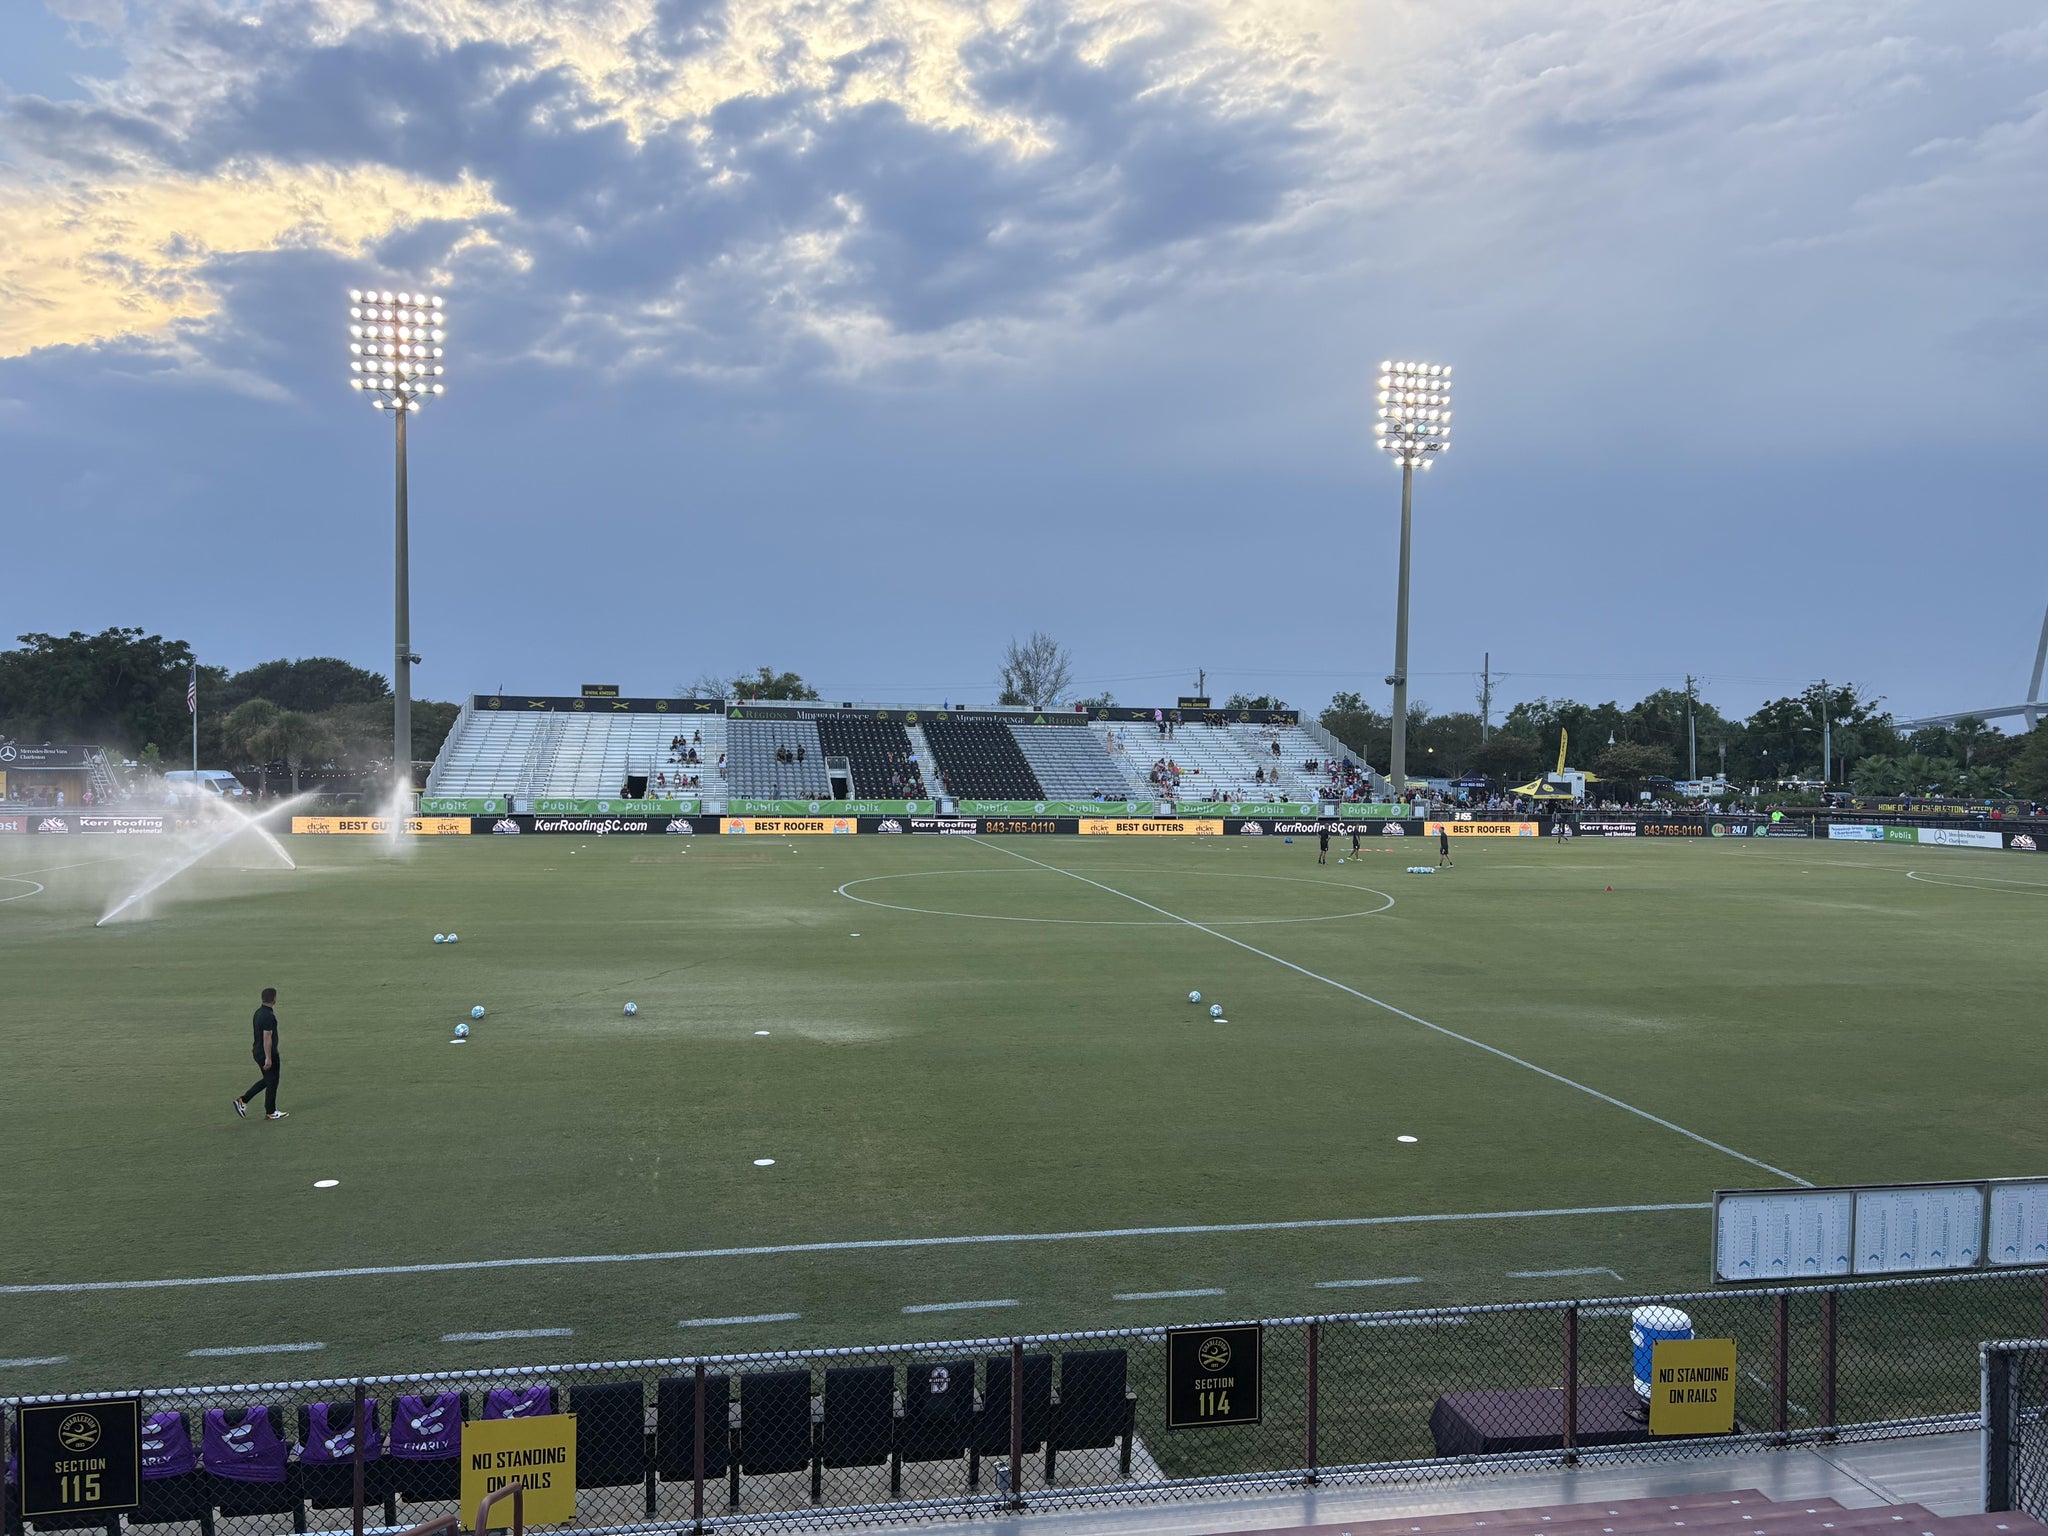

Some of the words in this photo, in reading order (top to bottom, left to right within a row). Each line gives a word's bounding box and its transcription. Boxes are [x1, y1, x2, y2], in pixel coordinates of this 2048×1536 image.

[746, 711, 788, 719] REGIONS
[1049, 716, 1087, 725] REGIONS
[430, 801, 468, 811] Publix
[542, 801, 580, 812] Publix
[626, 802, 662, 812] Publix
[746, 803, 780, 812] Publix
[845, 804, 879, 812] Publix
[976, 803, 1008, 812] Publix
[1068, 804, 1100, 813] Publix
[1184, 805, 1215, 813] Publix
[1254, 806, 1284, 814] Publix
[1348, 806, 1379, 814] Publix
[113, 819, 163, 827] Roofing
[339, 822, 368, 830] BEST
[371, 822, 423, 831] GUERS
[534, 819, 648, 834] KerrRoofingSC.com
[755, 822, 780, 831] BEST
[784, 822, 824, 831] ROOFER
[938, 821, 977, 829] Roofing
[986, 822, 1055, 833] 843-765-0110
[1116, 823, 1140, 831] BEST
[1142, 823, 1184, 832] GUTTERS
[1453, 825, 1474, 833] BEST
[1477, 825, 1511, 834] ROOFER
[1644, 825, 1703, 836] 843-765-0110
[1732, 826, 1748, 834] 24/7
[1890, 830, 1912, 839] Publix
[1202, 1340, 1228, 1353] CHARLESTON
[1660, 1369, 1674, 1383] NO
[1677, 1367, 1729, 1382] STANDING
[1195, 1377, 1234, 1390] SECTION
[1670, 1389, 1684, 1403] ON
[1687, 1388, 1717, 1403] RAILS
[1200, 1390, 1230, 1416] 114
[63, 1416, 97, 1431] CHARLESTON
[404, 1439, 449, 1452] CHARLY
[472, 1453, 492, 1470] NO
[497, 1447, 566, 1468] STANDING
[55, 1458, 106, 1474] SECTION
[61, 1473, 100, 1503] 115
